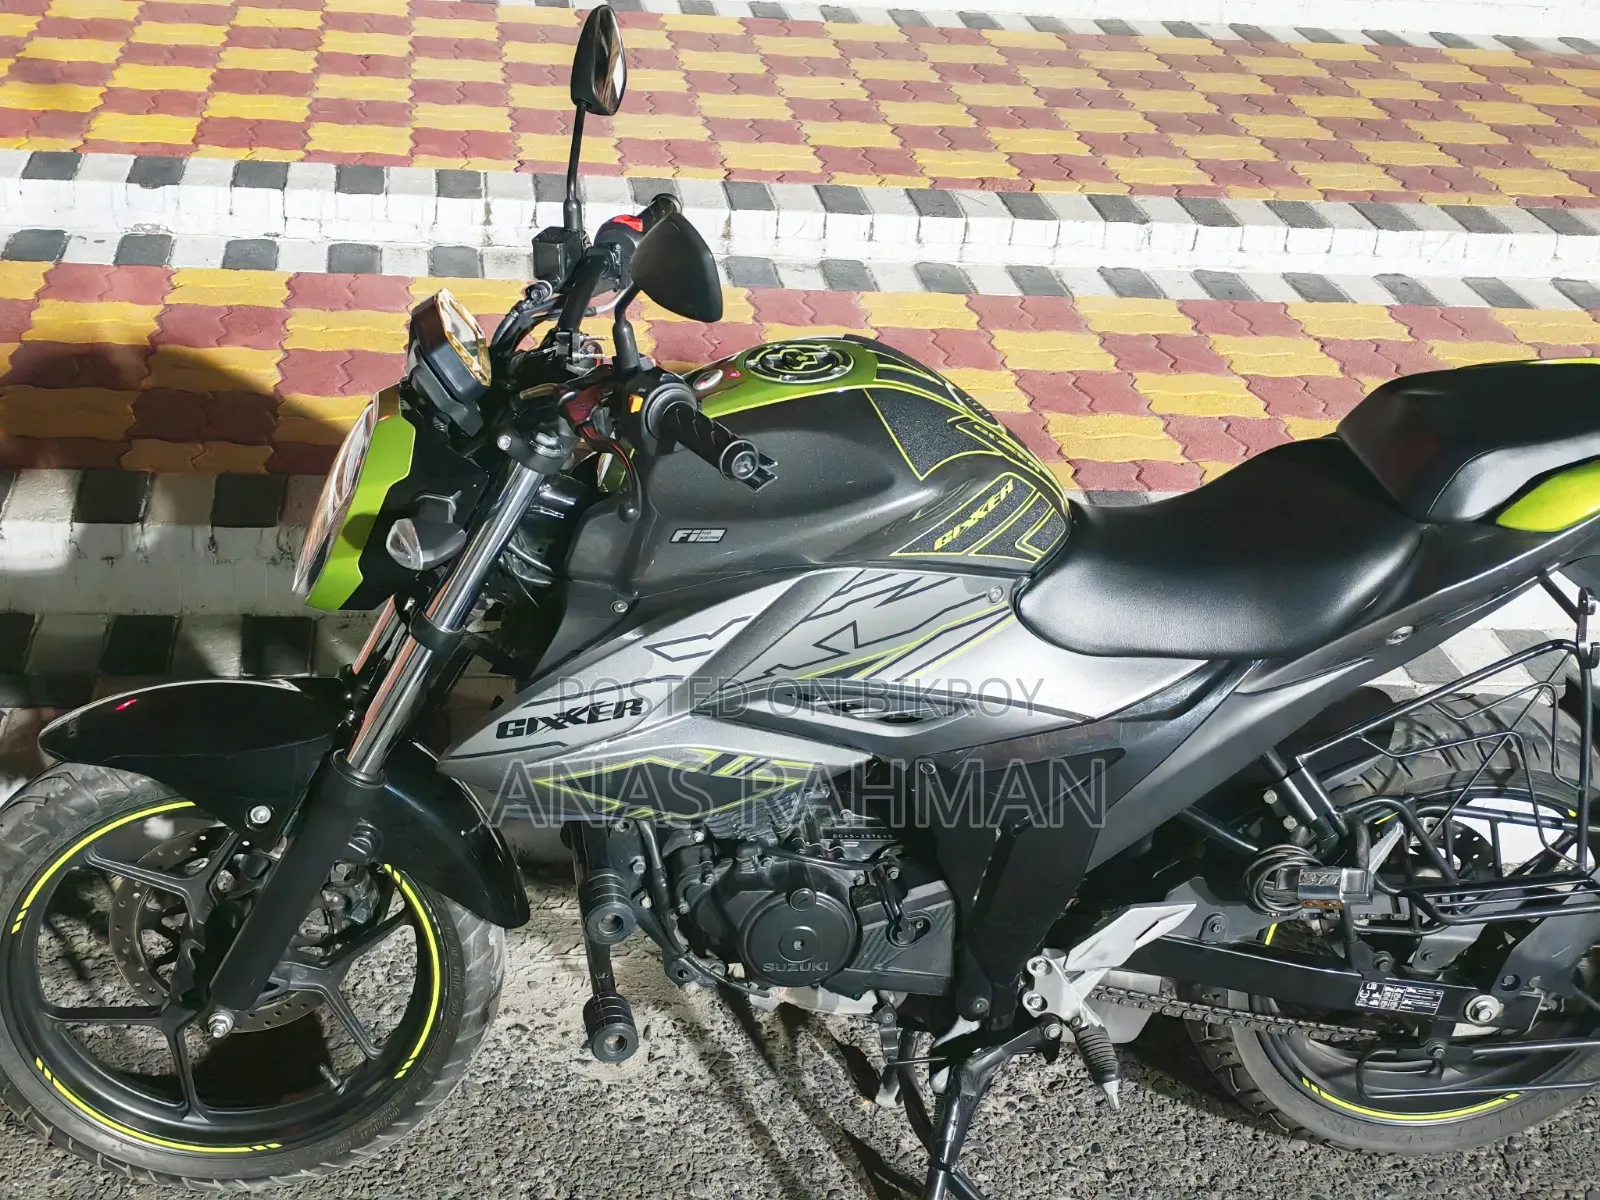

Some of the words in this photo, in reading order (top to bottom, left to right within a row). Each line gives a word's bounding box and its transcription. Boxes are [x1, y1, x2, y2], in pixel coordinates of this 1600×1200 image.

[934, 478, 1014, 551] GIXXER
[670, 529, 702, 542] Fi
[495, 697, 644, 740] GIXXER
[762, 961, 829, 972] SUZUKI
